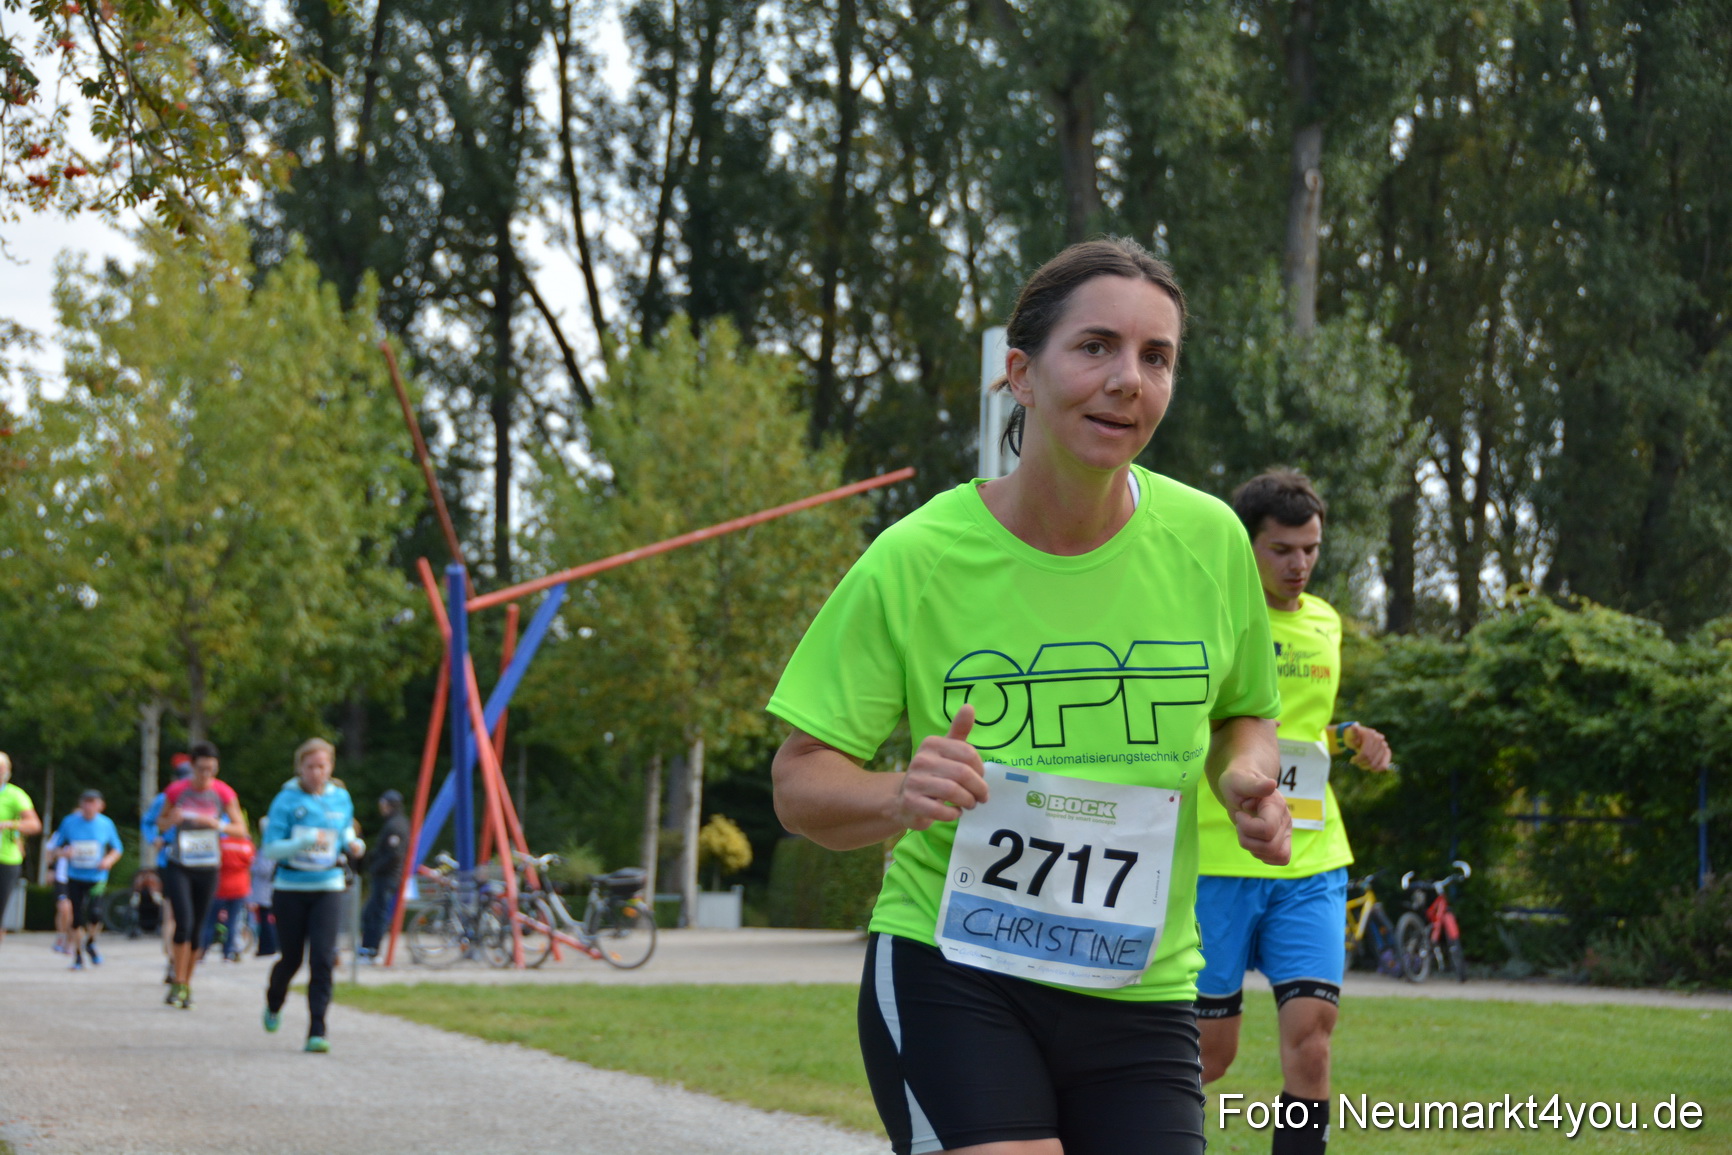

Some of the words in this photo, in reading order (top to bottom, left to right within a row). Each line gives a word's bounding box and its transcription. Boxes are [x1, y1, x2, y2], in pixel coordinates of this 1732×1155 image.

[1011, 755, 1033, 766] und
[1037, 752, 1179, 767] Automatisierungstechnik
[1182, 746, 1205, 762] GmbH
[1047, 794, 1118, 819] BOCK
[960, 872, 968, 883] D
[982, 828, 1139, 908] 2717
[963, 908, 1143, 966] CHRISTINE
